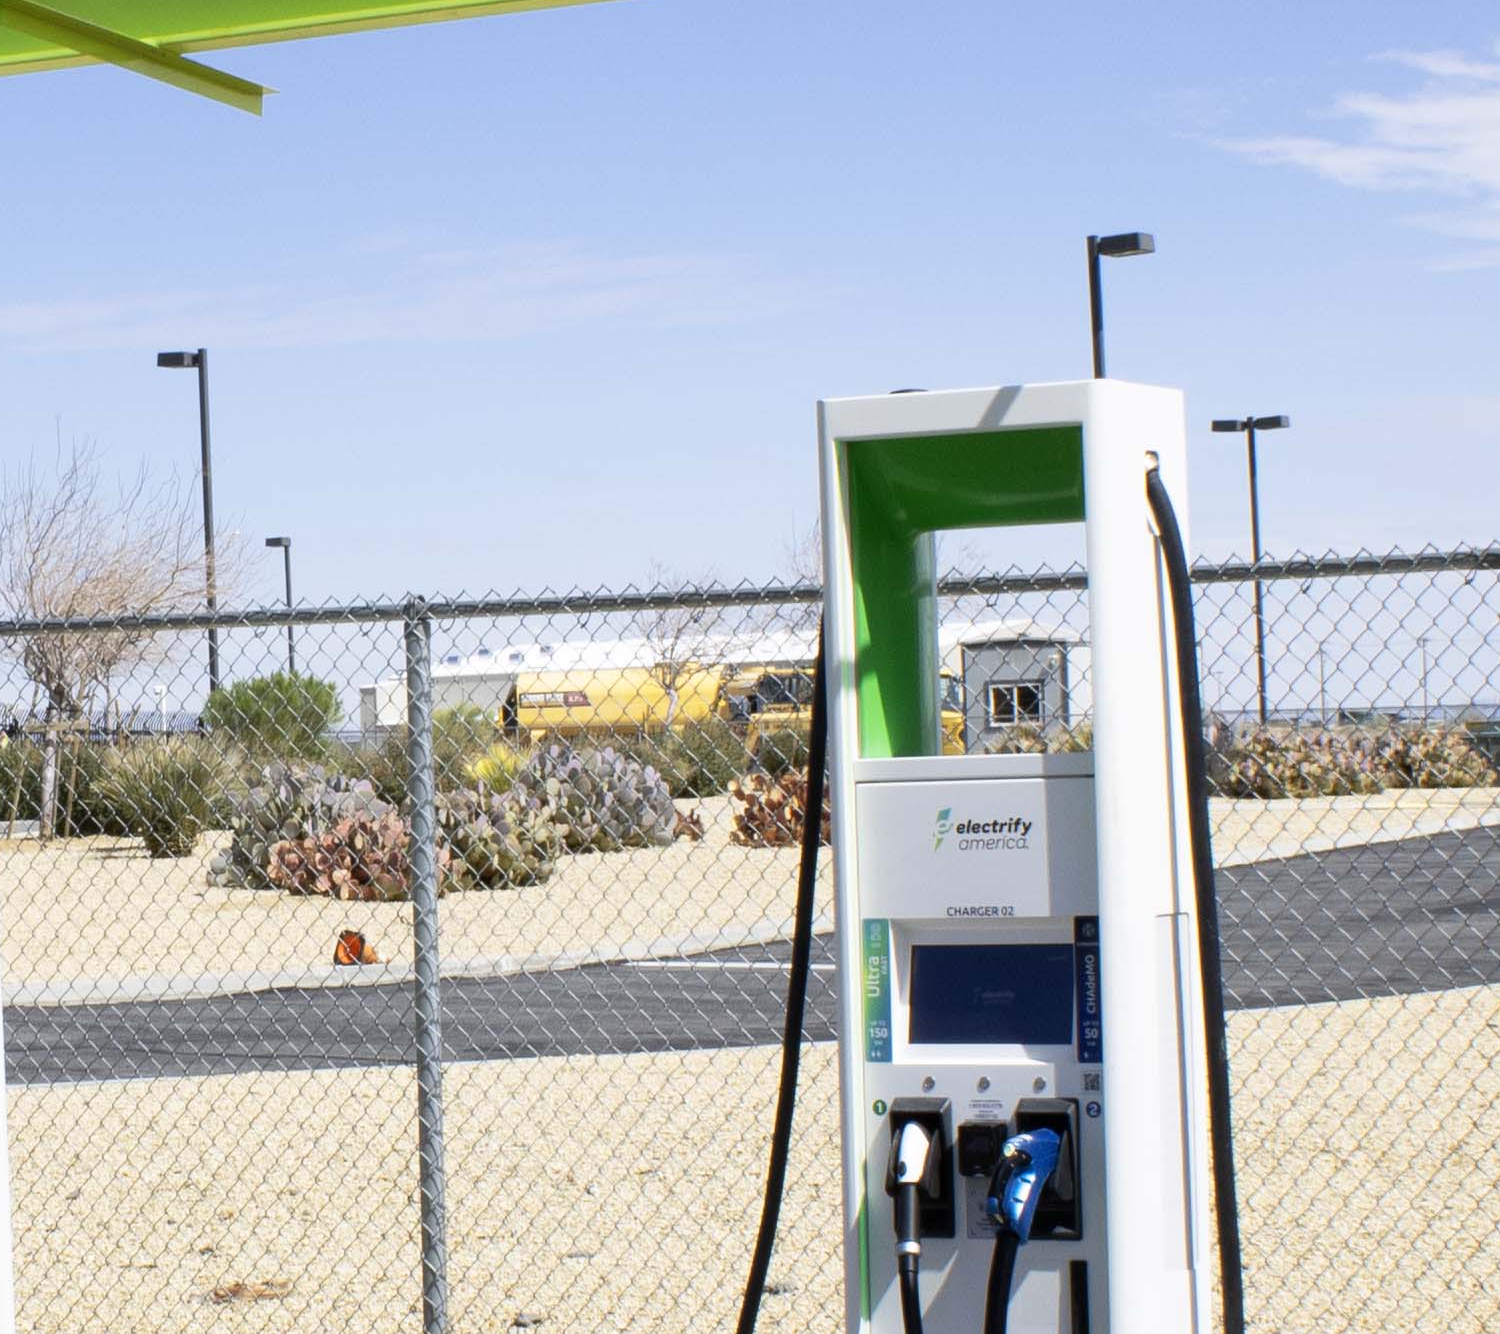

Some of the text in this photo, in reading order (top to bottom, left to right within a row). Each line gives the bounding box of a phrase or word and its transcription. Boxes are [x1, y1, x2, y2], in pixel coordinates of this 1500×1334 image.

[956, 817, 1032, 836] electrify
[946, 906, 1014, 917] CHARGER 02
[867, 956, 880, 998] Ultra
[1084, 954, 1096, 1014] CHAdeMO
[870, 1027, 888, 1038] 150
[1085, 1028, 1098, 1039] 50
